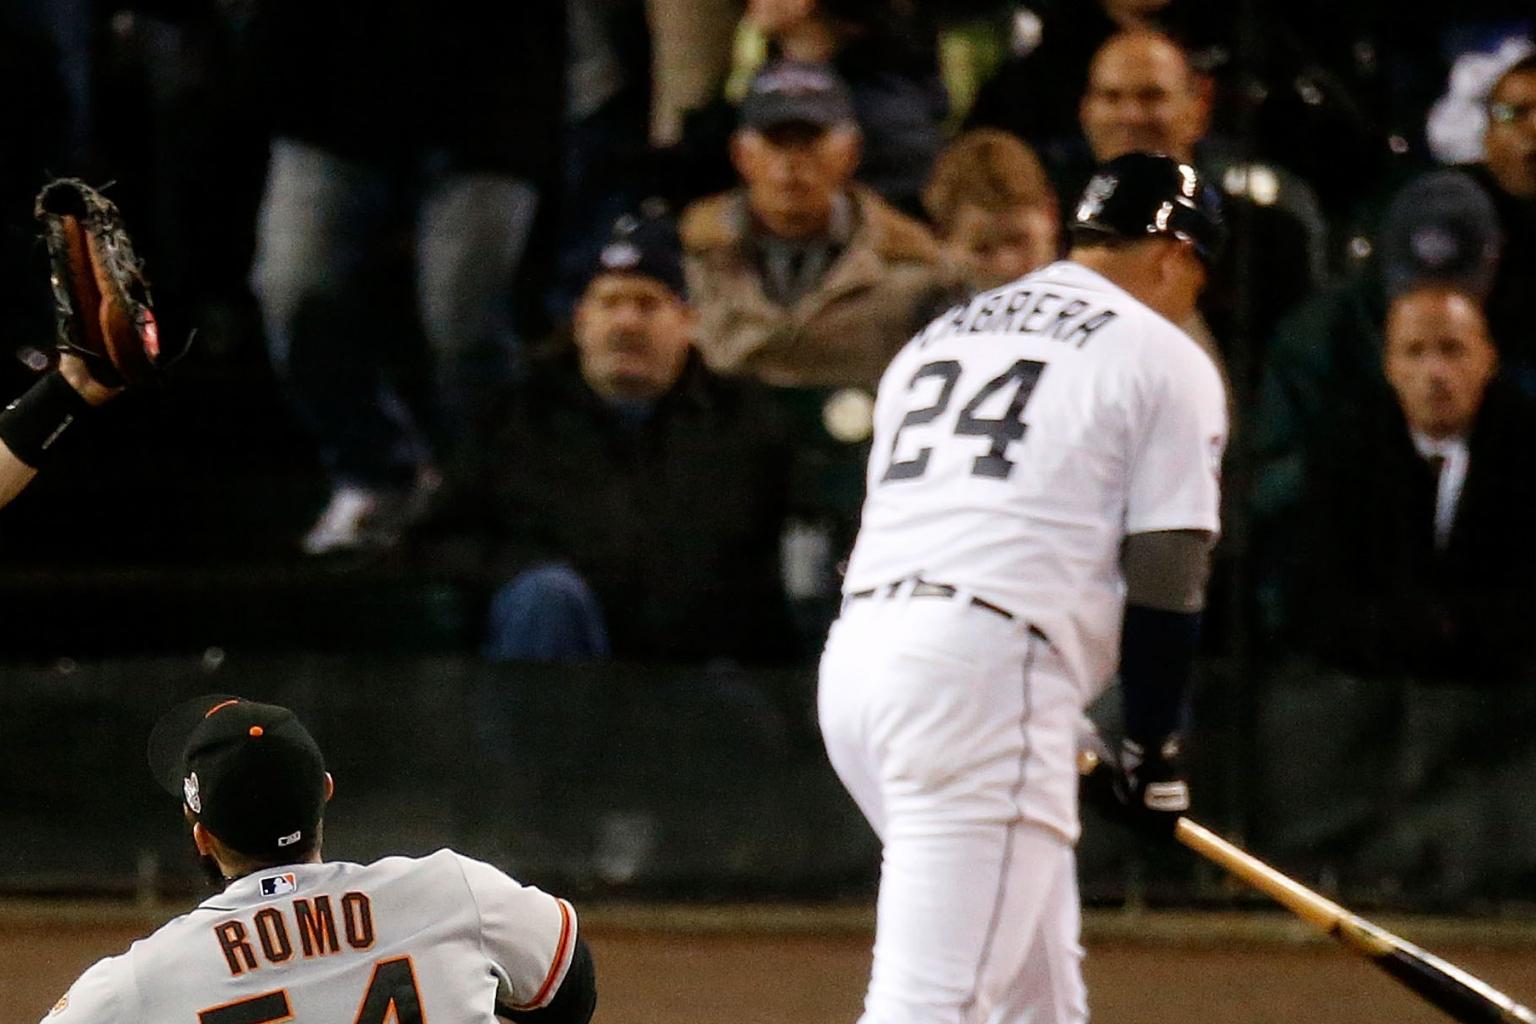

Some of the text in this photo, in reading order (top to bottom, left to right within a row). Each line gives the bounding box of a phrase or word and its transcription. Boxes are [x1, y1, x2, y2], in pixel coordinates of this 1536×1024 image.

[916, 289, 1119, 350] ABRERA
[878, 359, 1048, 484] 24
[214, 890, 377, 977] ROMO
